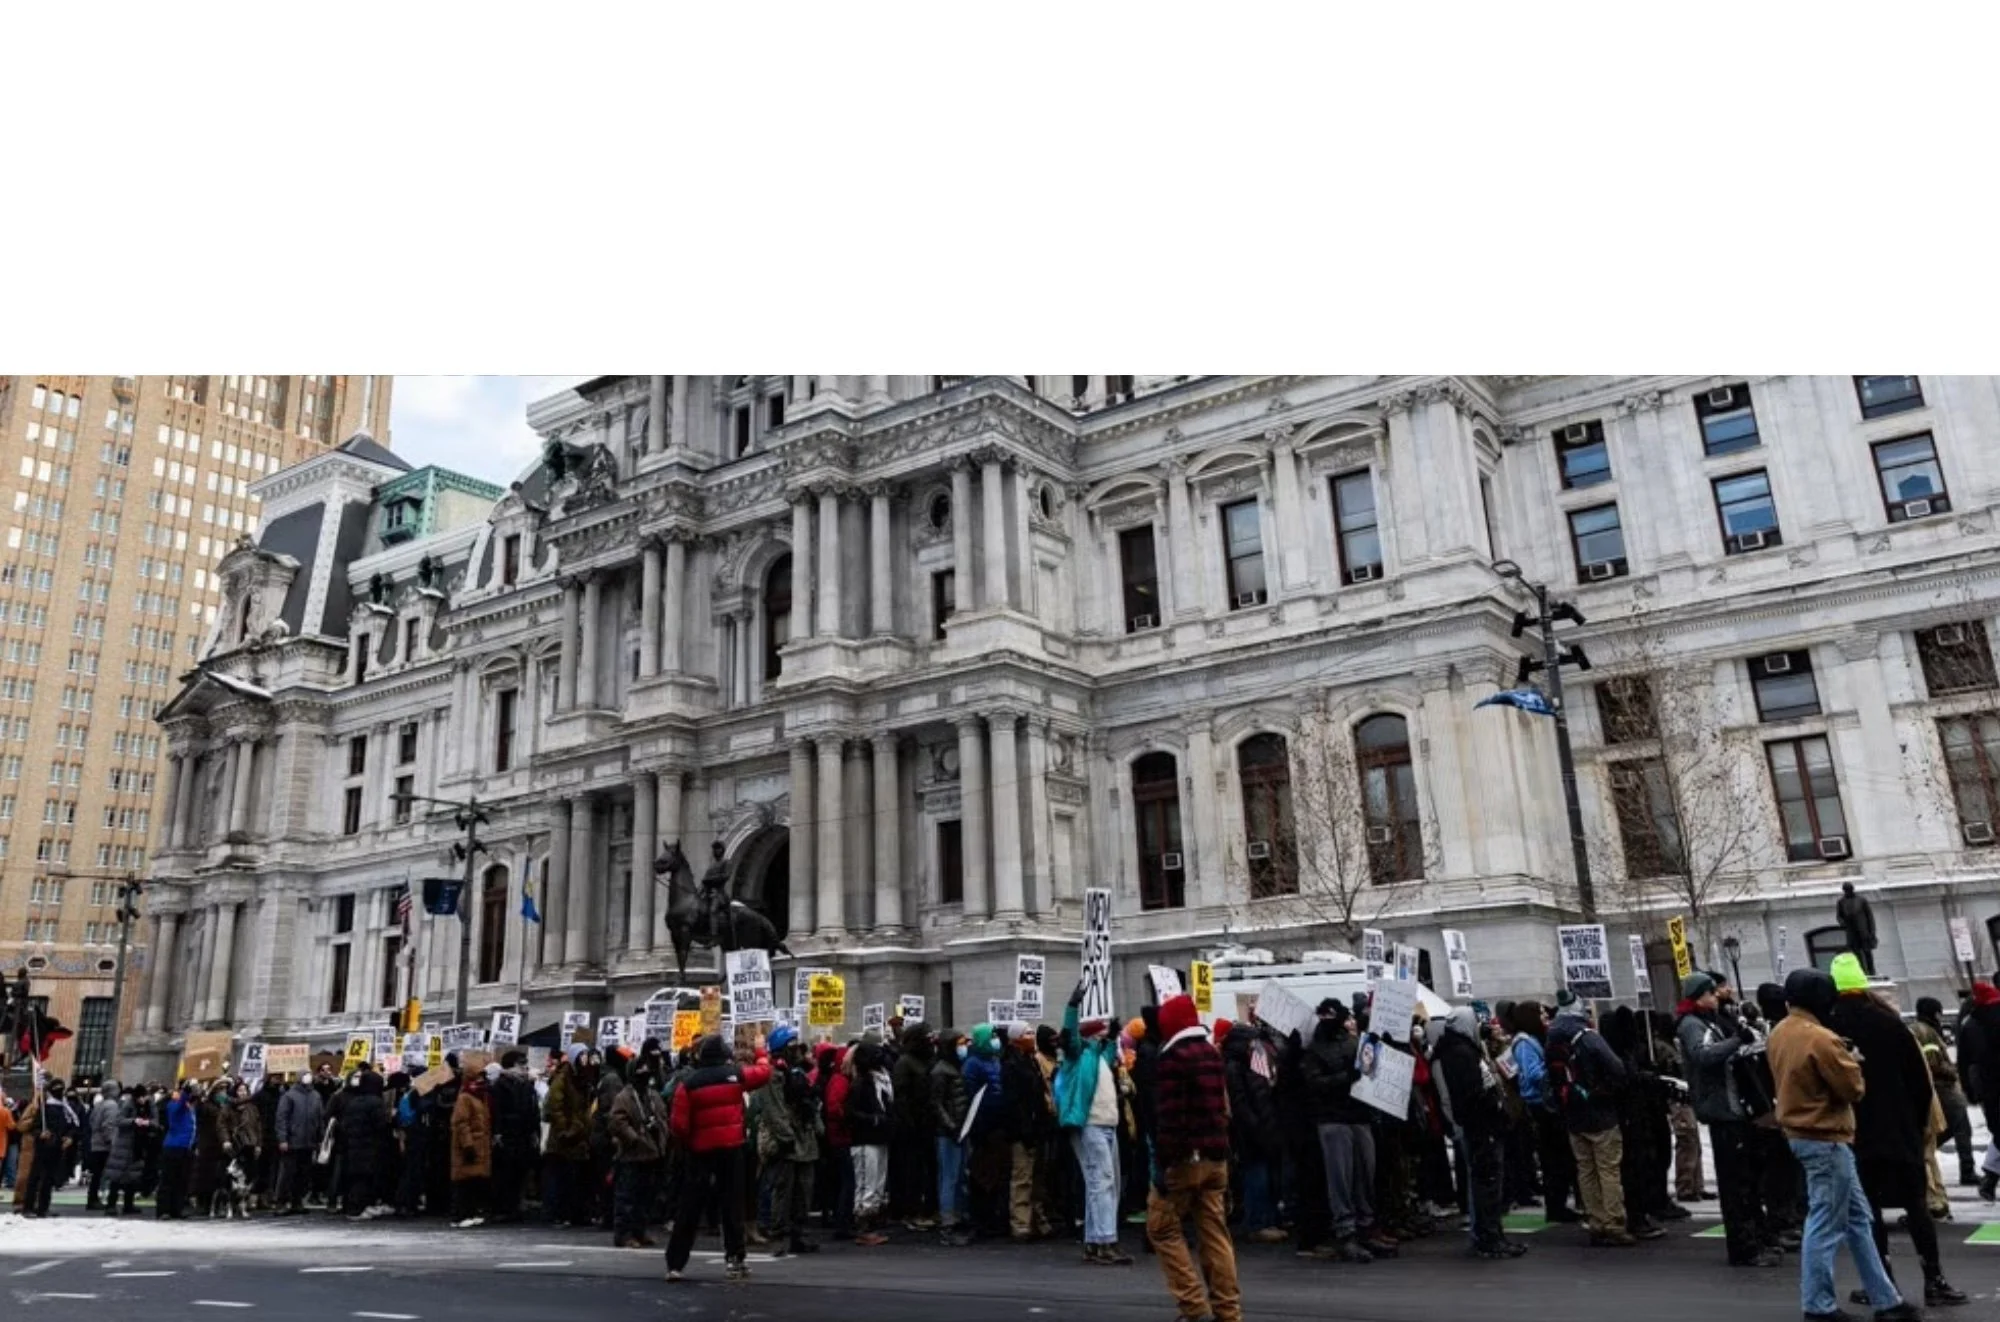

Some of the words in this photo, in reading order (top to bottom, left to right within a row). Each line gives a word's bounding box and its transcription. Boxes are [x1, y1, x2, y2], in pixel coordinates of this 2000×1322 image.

[1019, 971, 1043, 986] ICE
[1080, 963, 1111, 1018] PAY
[902, 1006, 922, 1018] ICE
[498, 1014, 514, 1033] ICE
[601, 1019, 619, 1036] ICE
[247, 1044, 262, 1060] ICE
[350, 1039, 366, 1056] ICE
